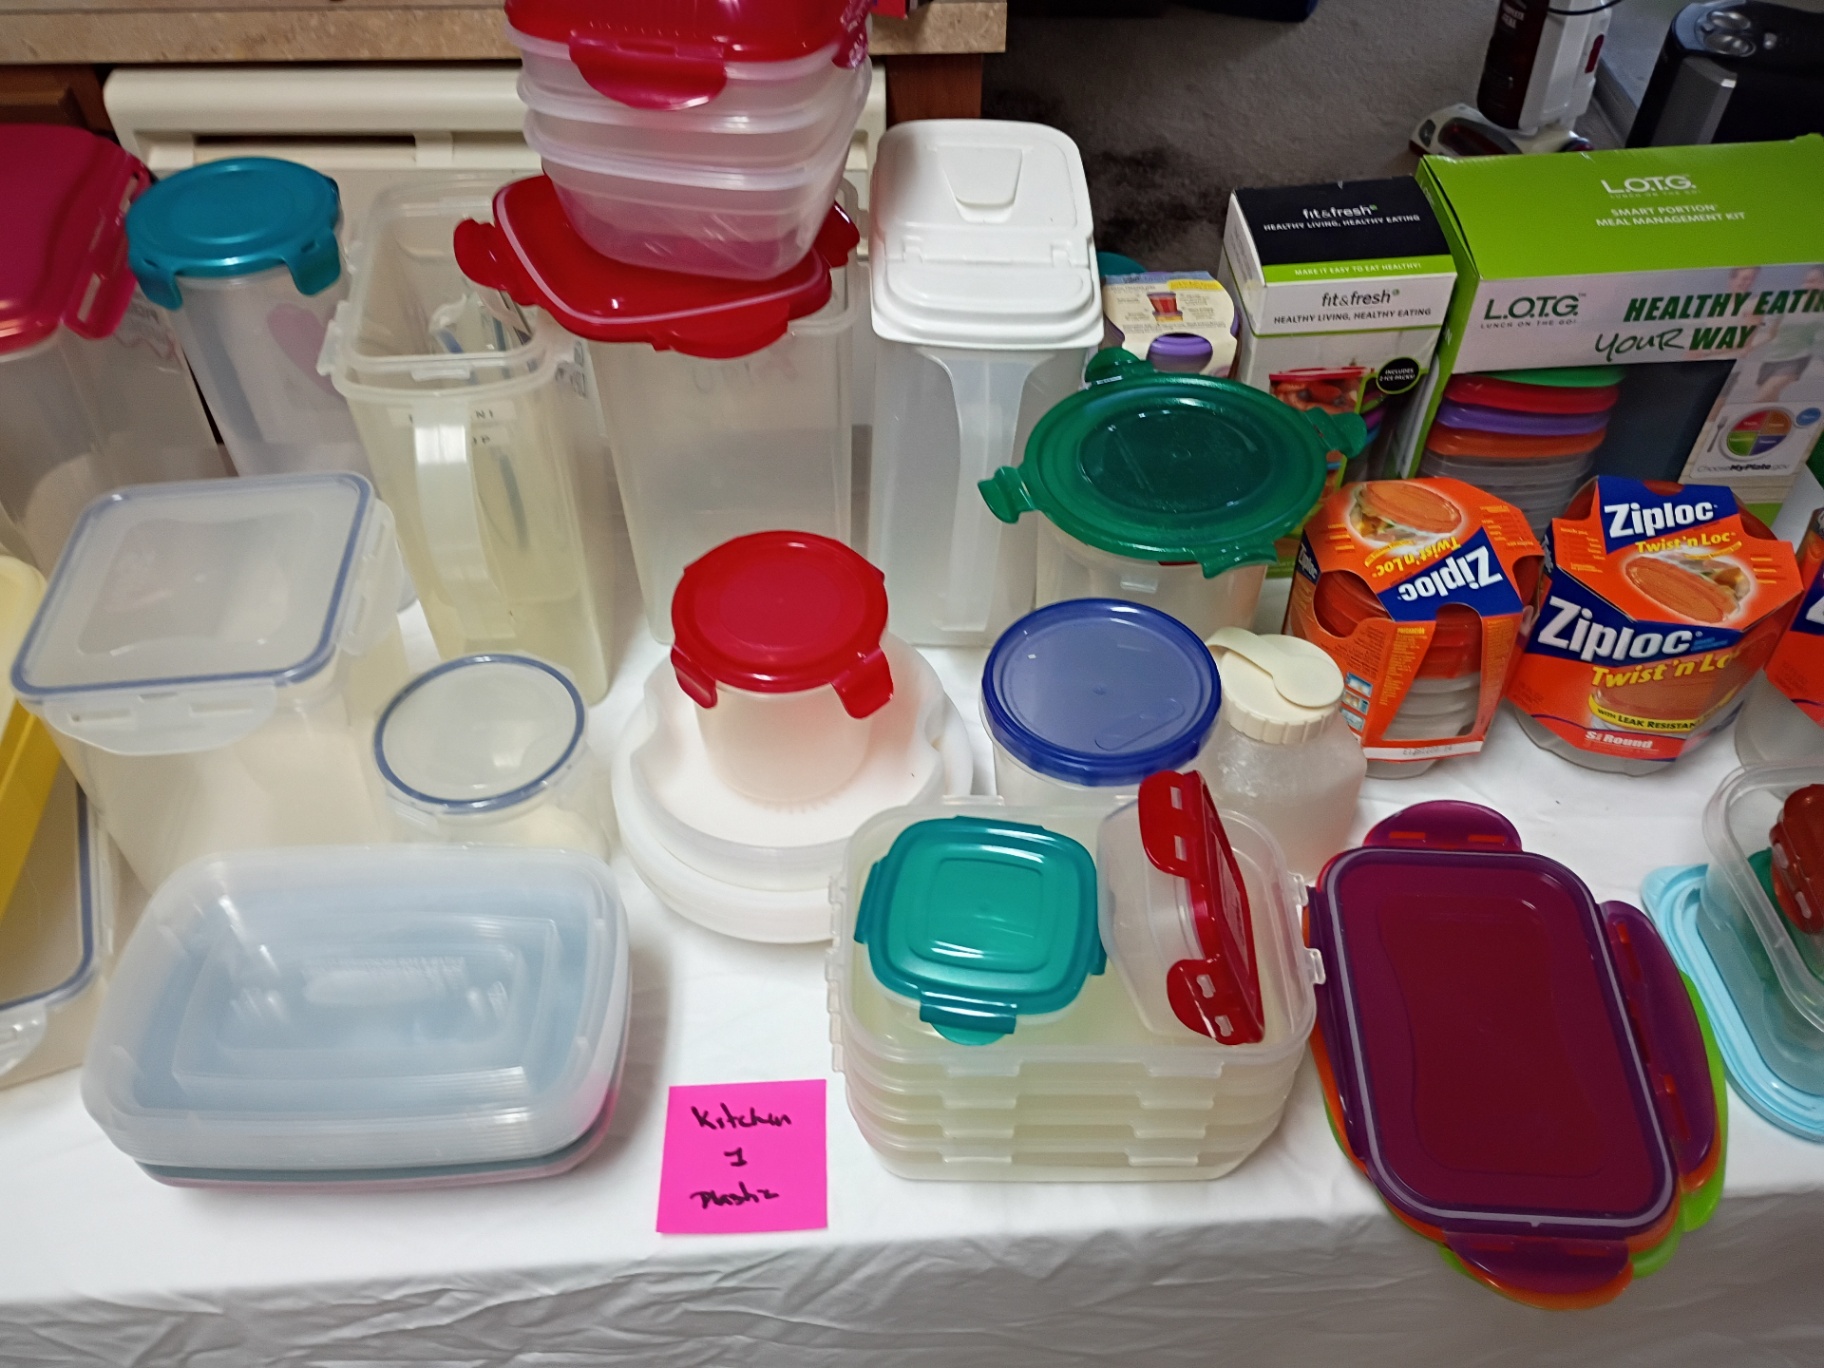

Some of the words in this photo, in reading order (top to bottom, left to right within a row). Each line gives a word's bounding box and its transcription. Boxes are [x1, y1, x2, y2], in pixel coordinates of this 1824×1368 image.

[1595, 218, 1631, 227] MEAL
[1632, 213, 1723, 226] MANAGEMENT
[1725, 211, 1746, 220] KIT
[1611, 207, 1655, 217] SMART
[1658, 204, 1715, 215] PORTION
[1263, 222, 1305, 232] HEALTHY
[1343, 216, 1383, 227] HEALTHY
[1386, 214, 1421, 223] EATING
[1294, 268, 1319, 276] MAKE
[1329, 267, 1351, 275] EASY
[1352, 266, 1364, 274] TO
[1366, 265, 1380, 273] EAT
[1381, 263, 1422, 272] HEALTHY!
[1321, 289, 1392, 307] fit&fresh
[1484, 294, 1579, 320] L.O.T.G.
[1623, 292, 1752, 322] HEALTHY
[1274, 315, 1316, 325] HEALTHY
[1317, 313, 1351, 322] LIVING,
[1353, 310, 1396, 321] HEALTHY
[1397, 308, 1432, 317] EATING
[1481, 322, 1513, 330] LUNCH
[1688, 325, 1757, 350] WAY
[1604, 501, 1714, 539] Ziploc
[1419, 536, 1462, 562] Twist
[1635, 538, 1681, 554] Twist
[1701, 532, 1731, 547] Loc
[1397, 545, 1504, 602] Ziploc
[1538, 595, 1693, 663] Ziploc
[1591, 661, 1668, 688] Twist
[1597, 708, 1616, 719] WITH
[1617, 714, 1645, 727] LEAK
[1647, 719, 1697, 730] RESISTAN
[1602, 733, 1653, 749] Round
[691, 1102, 792, 1130] Kitchen
